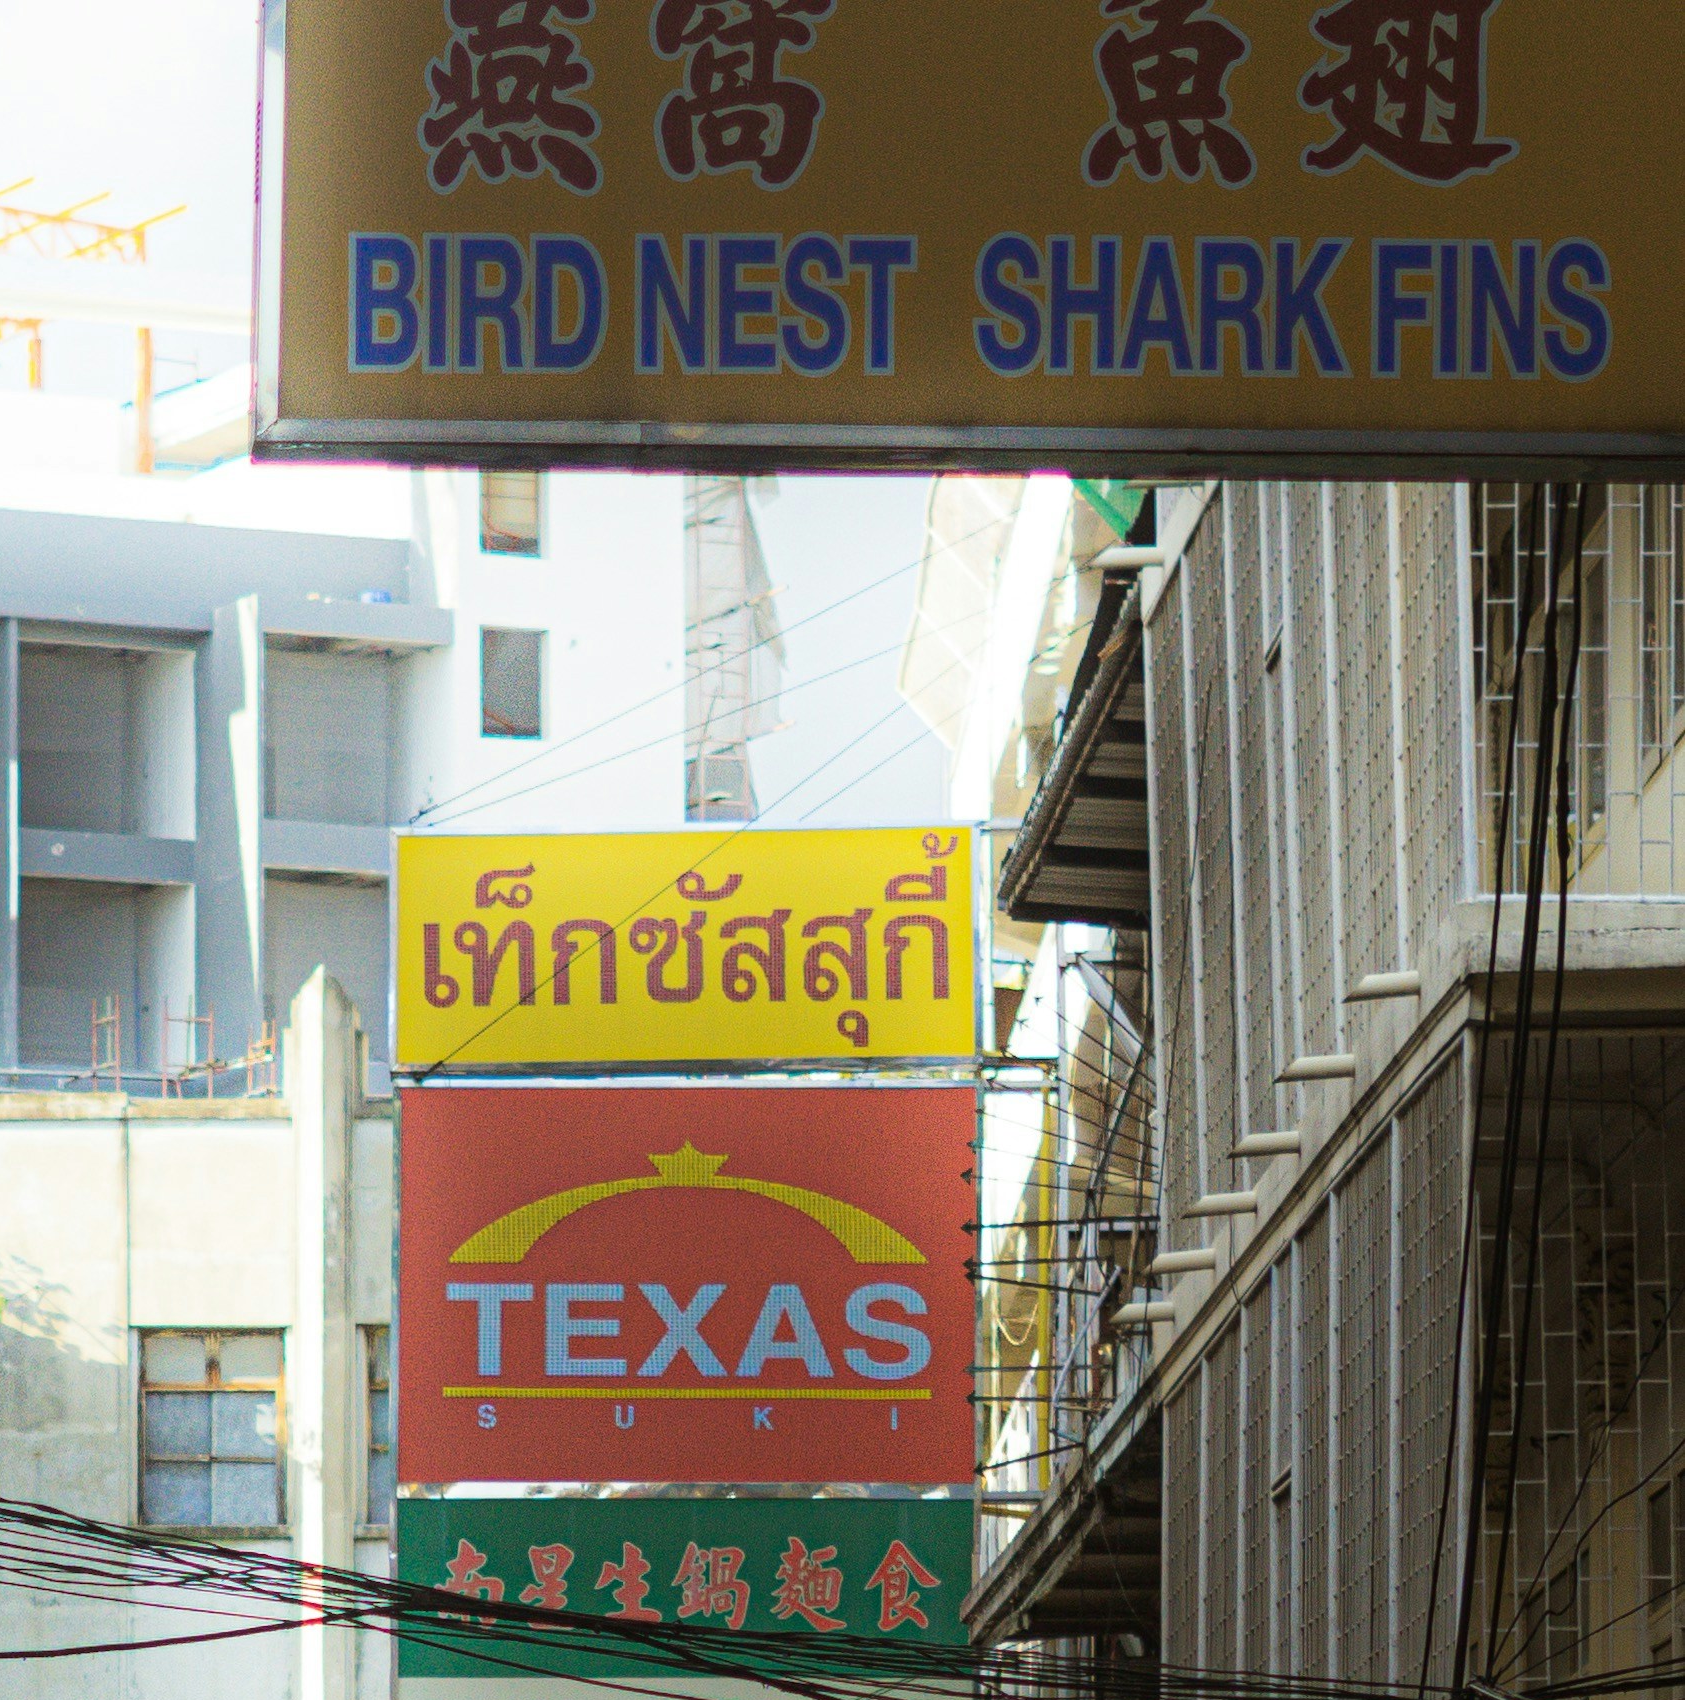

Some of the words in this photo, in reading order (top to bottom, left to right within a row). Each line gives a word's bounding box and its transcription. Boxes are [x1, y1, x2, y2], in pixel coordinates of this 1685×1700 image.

[347, 232, 608, 374] BIRD
[634, 233, 916, 376] NEST
[973, 233, 1354, 379] SHARK
[1369, 235, 1612, 381] FINS
[424, 832, 958, 1047] เท็กซัสสุกี้
[446, 1283, 932, 1380] TEXAS
